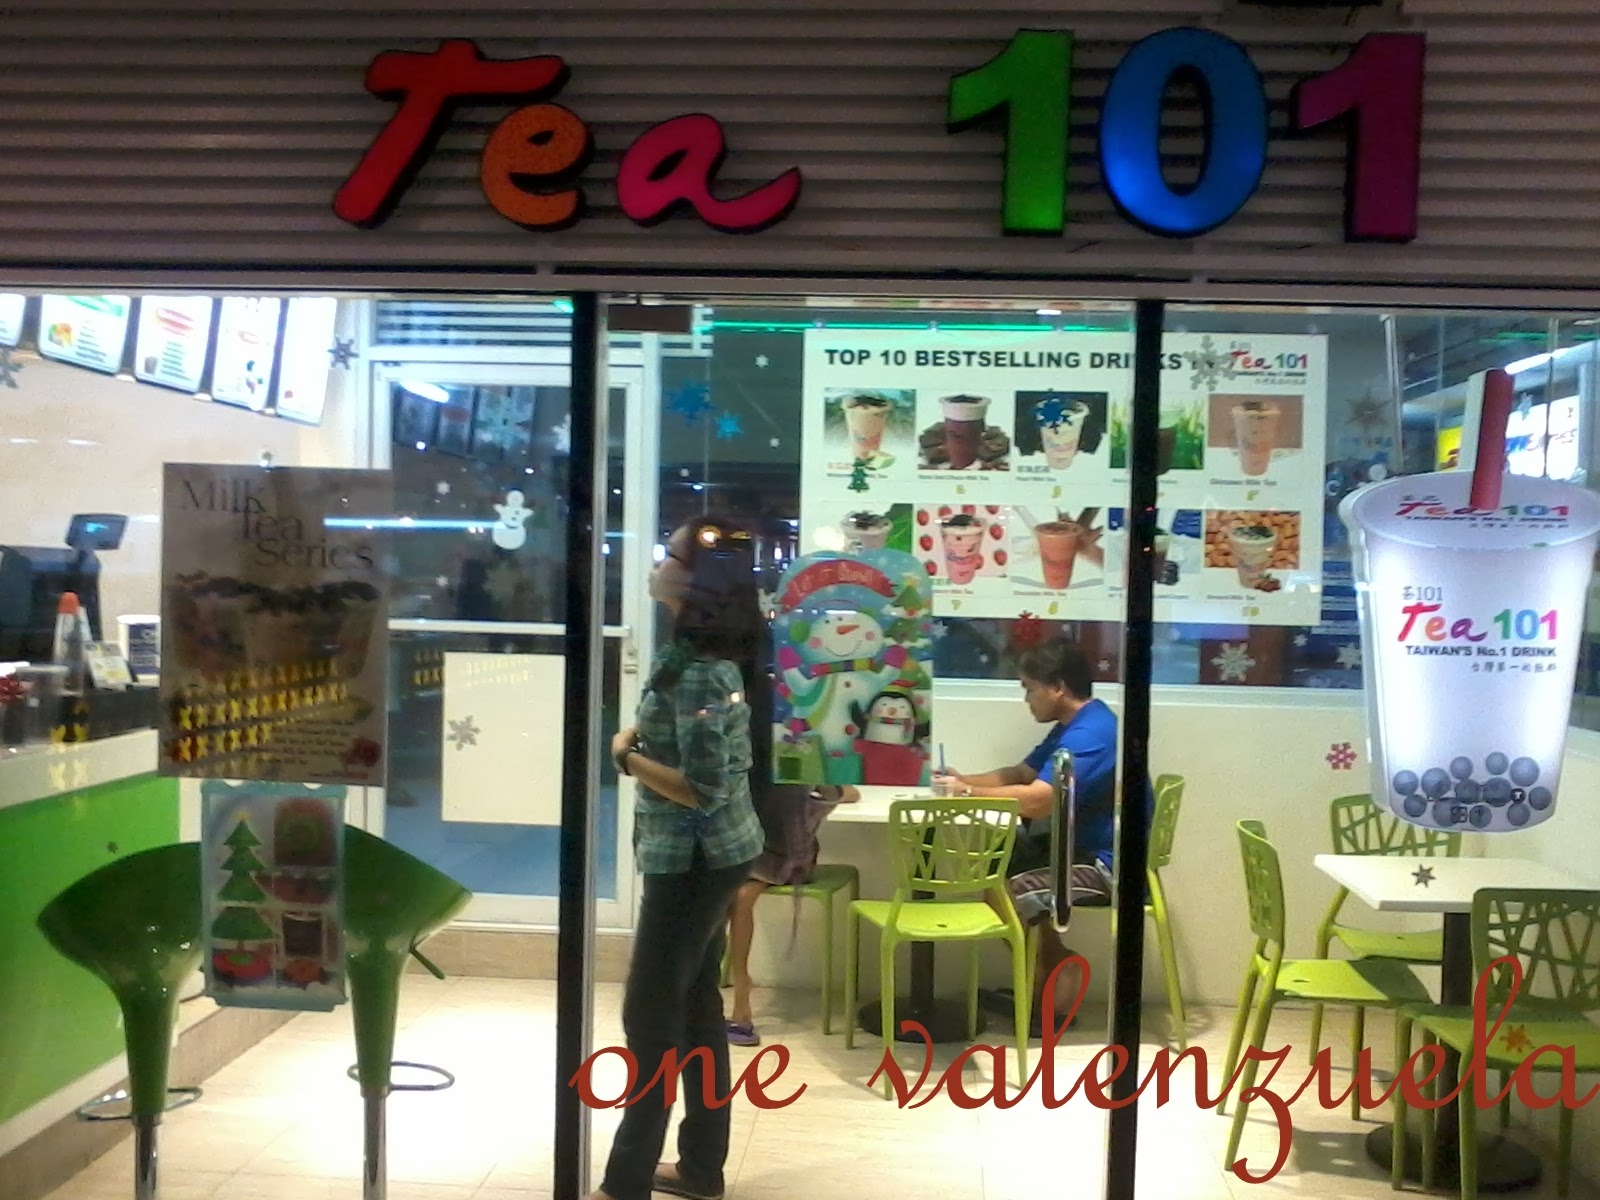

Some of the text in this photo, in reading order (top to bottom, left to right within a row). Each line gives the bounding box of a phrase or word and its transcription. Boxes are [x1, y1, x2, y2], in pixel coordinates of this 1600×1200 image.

[333, 26, 1427, 242] Tea 101
[825, 348, 871, 366] TOP
[880, 349, 907, 366] 10
[915, 350, 1081, 369] BESTSELLING
[1090, 352, 1183, 370] DRIS
[1228, 349, 1273, 369] Tea
[1274, 353, 1308, 369] 101
[1502, 503, 1569, 516] 101
[1398, 602, 1558, 643] Tea 101
[1405, 645, 1473, 656] TAIWAN'S
[1512, 646, 1557, 657] DRINK
